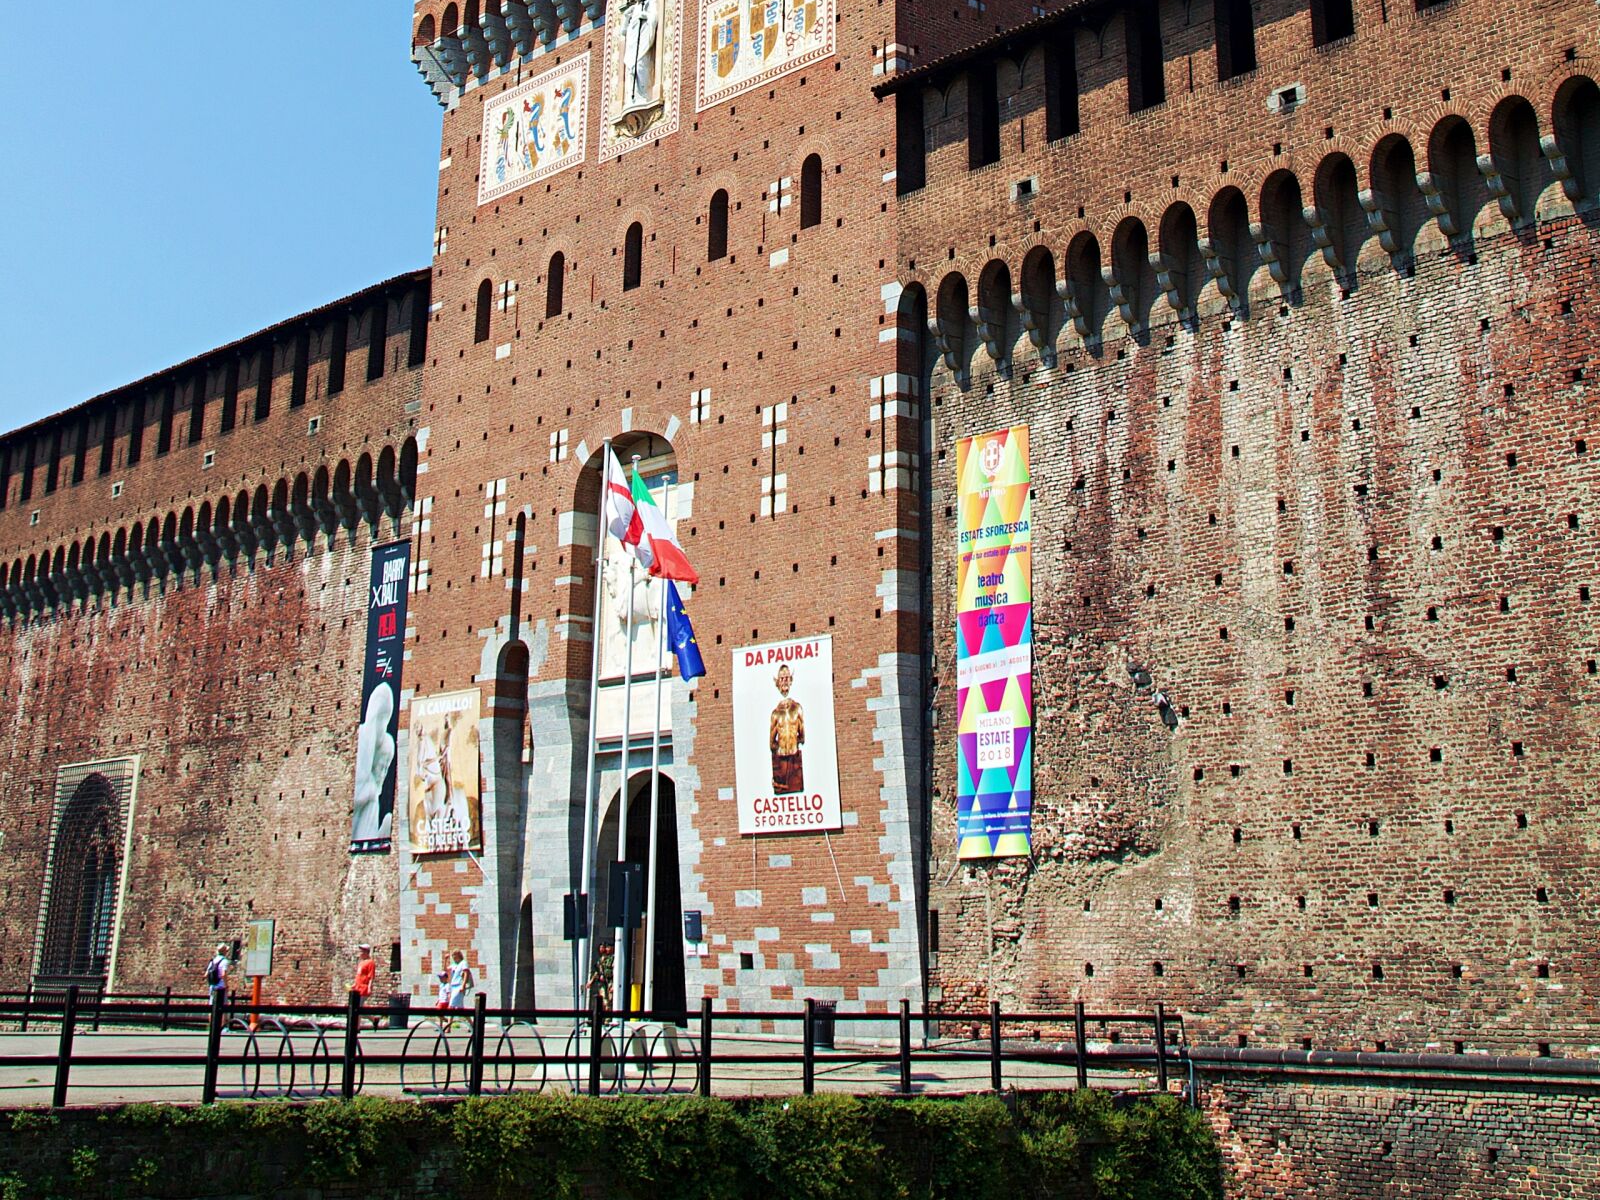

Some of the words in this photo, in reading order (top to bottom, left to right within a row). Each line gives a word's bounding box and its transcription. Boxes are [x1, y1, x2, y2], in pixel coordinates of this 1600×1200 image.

[960, 528, 984, 543] ESTATE
[985, 520, 1029, 538] SFORZESCA
[382, 557, 406, 584] BARRY
[977, 573, 1005, 588] teatro
[381, 581, 399, 608] BALL
[975, 592, 1009, 608] musica
[978, 611, 1005, 628] danza
[745, 650, 764, 667] DA
[767, 642, 819, 664] PAURA!
[417, 703, 426, 717] A
[426, 696, 473, 715] CAVALLO!
[979, 715, 1011, 729] MILANO
[979, 730, 1011, 746] ESTATE
[980, 746, 1011, 762] 2018
[753, 794, 823, 814] CASTELLO
[416, 817, 471, 834] CASTELLO
[754, 812, 824, 828] SFORZESCO
[417, 832, 471, 846] SFORZESCO
